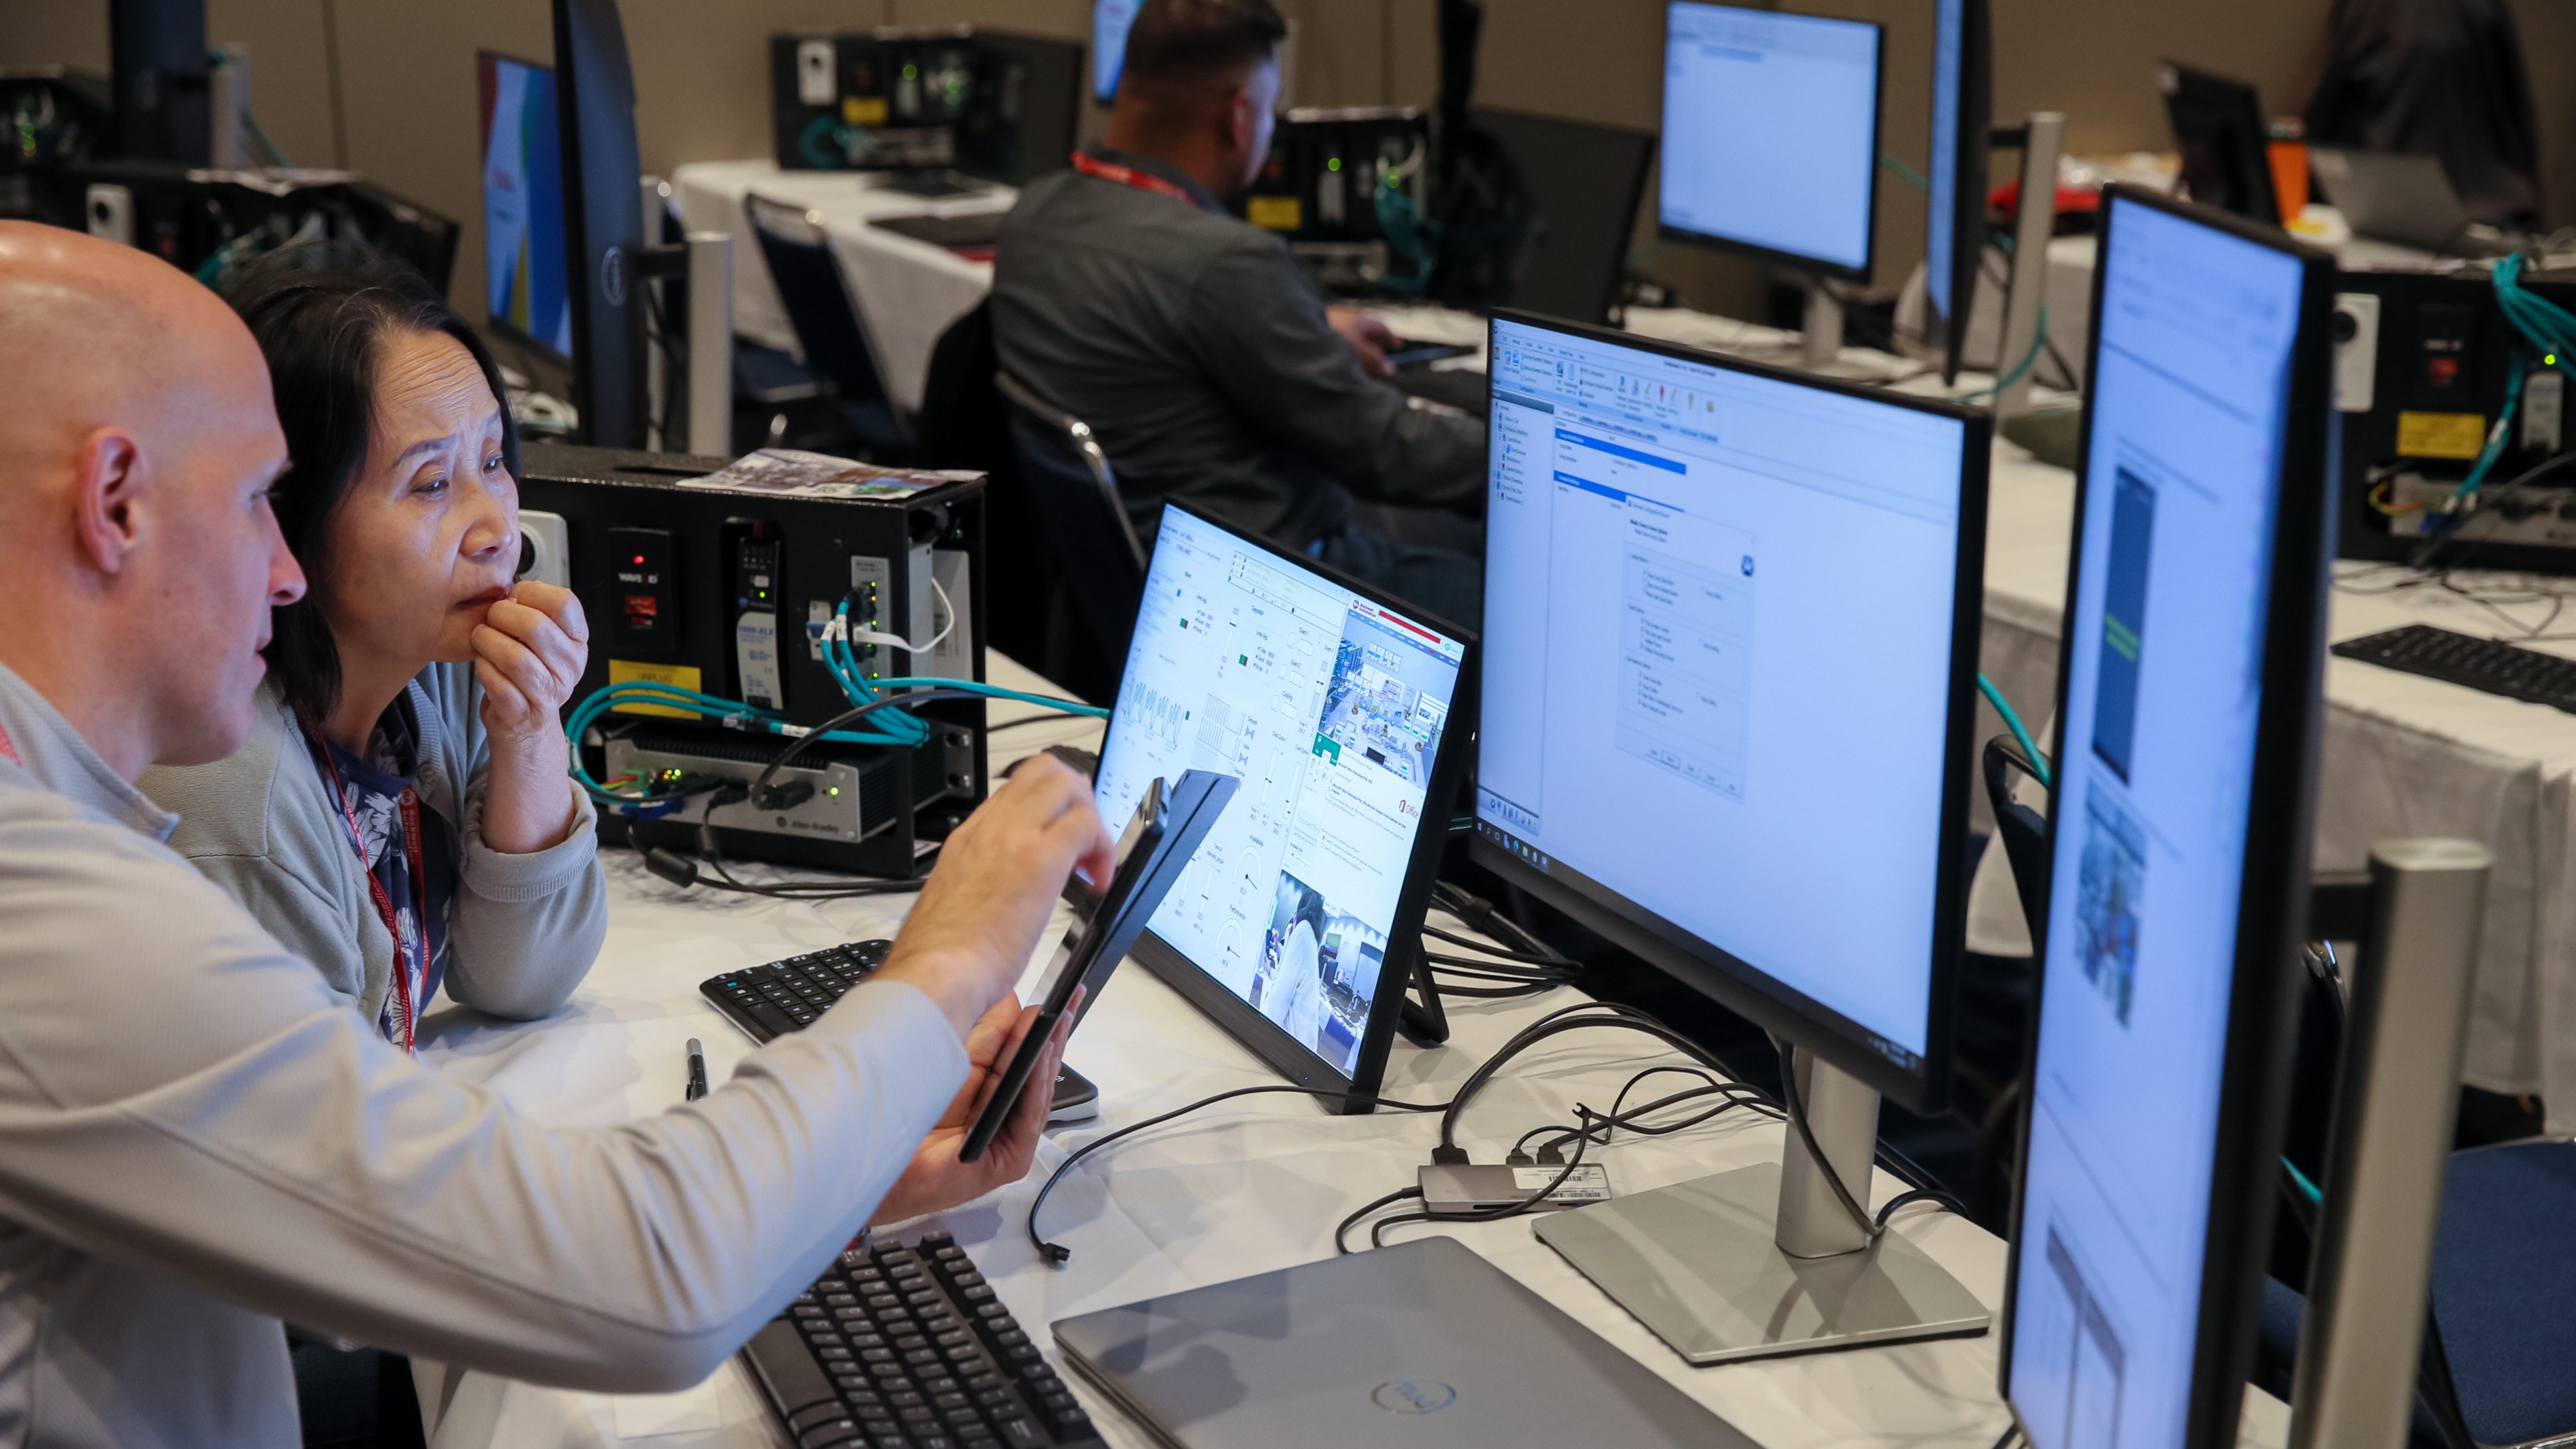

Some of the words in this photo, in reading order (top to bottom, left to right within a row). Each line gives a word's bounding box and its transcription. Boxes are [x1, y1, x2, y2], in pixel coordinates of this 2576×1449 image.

[1358, 606, 1377, 619] Automation
[1359, 602, 1374, 613] Rockwell
[1290, 658, 1301, 669] Oven-2
[1281, 689, 1294, 702] Cooling
[1404, 802, 1420, 820] Office
[409, 810, 418, 853] Rockwell
[791, 820, 839, 834] Allen-Bradley
[402, 810, 414, 864] Automation
[1249, 833, 1264, 848] Availability
[1228, 903, 1246, 921] Performance
